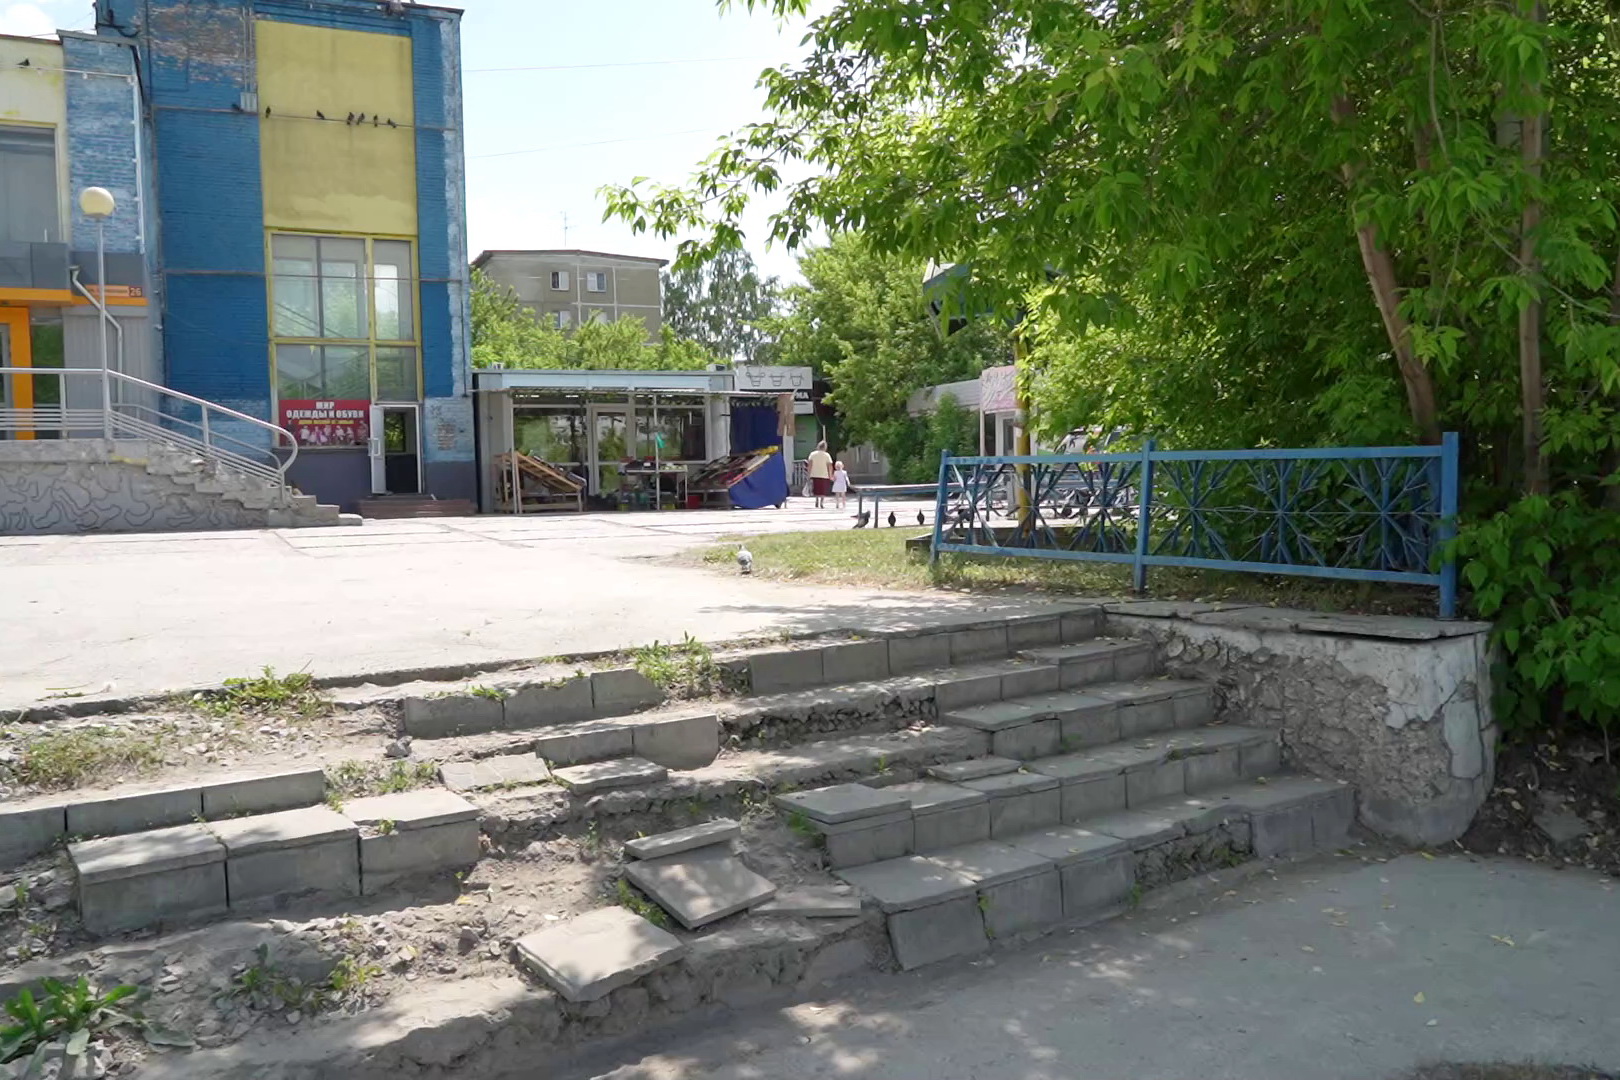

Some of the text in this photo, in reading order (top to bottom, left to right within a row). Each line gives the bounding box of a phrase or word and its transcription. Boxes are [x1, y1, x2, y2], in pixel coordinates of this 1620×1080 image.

[130, 287, 142, 297] 26
[316, 401, 335, 409] МИР
[286, 410, 364, 419] ОДЕЖДЫ И ОБУВИ
